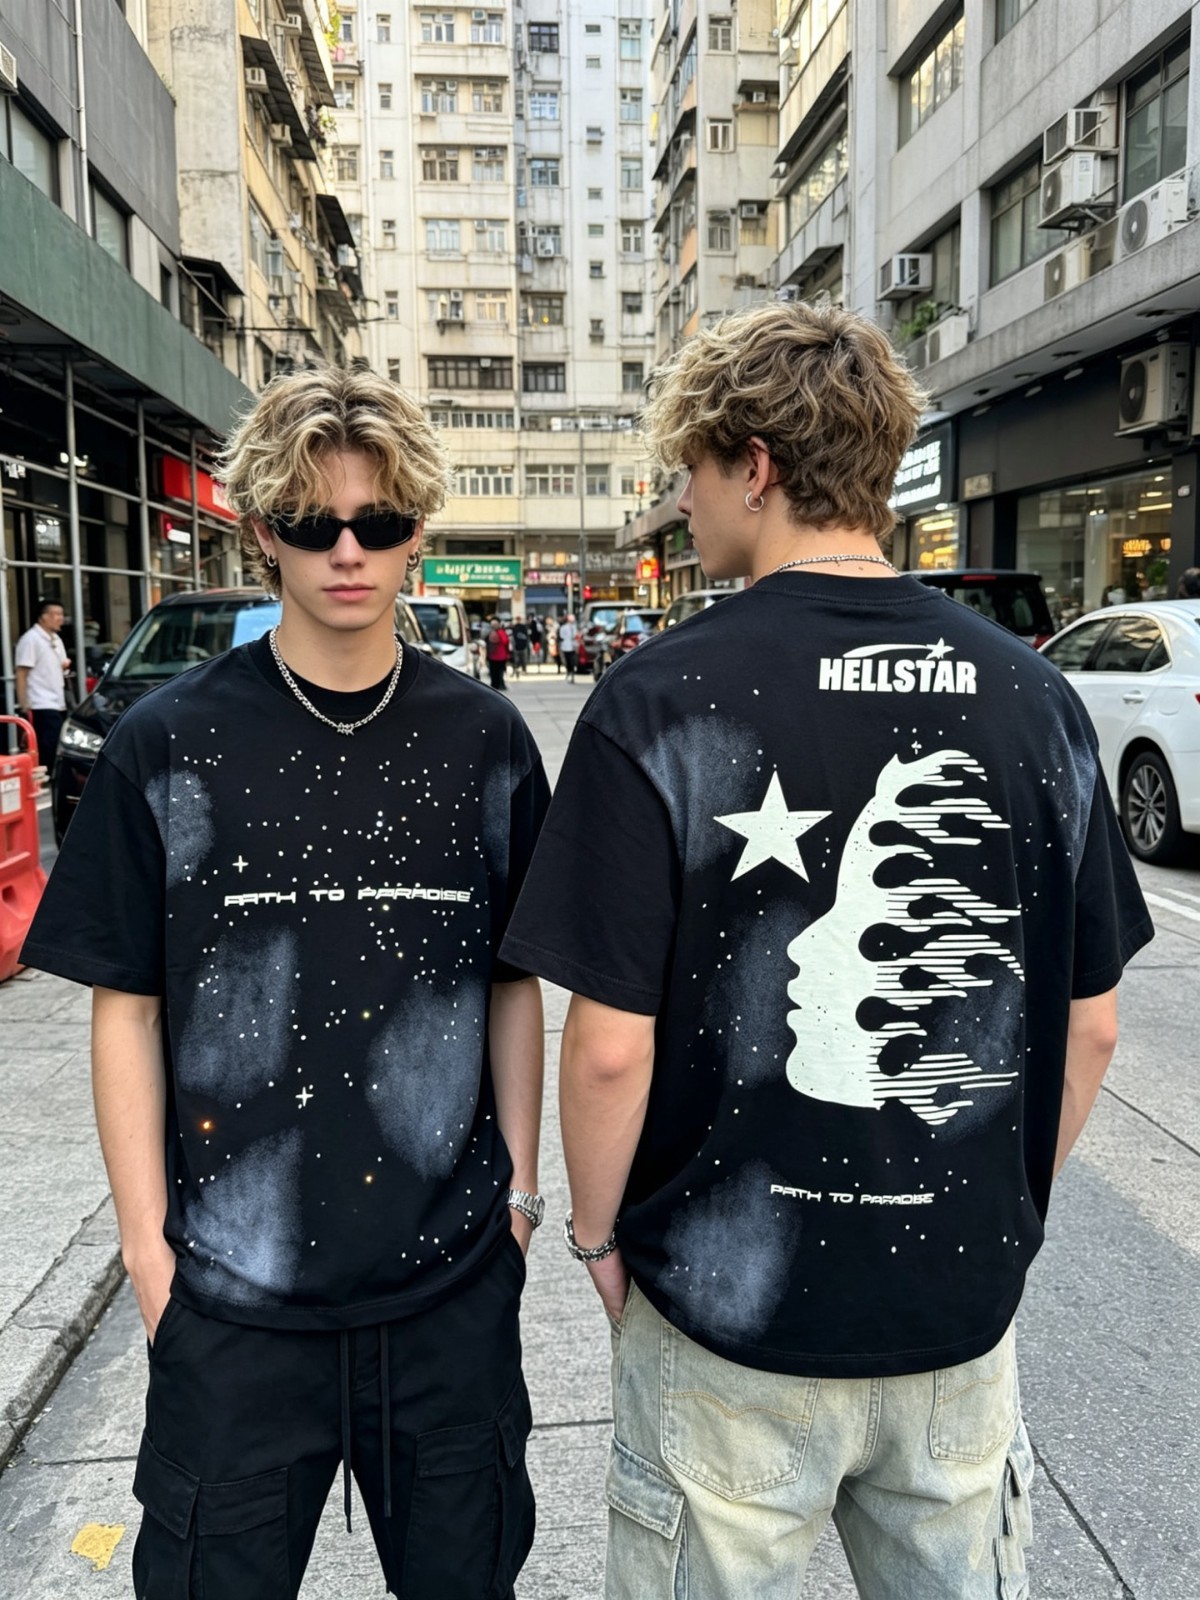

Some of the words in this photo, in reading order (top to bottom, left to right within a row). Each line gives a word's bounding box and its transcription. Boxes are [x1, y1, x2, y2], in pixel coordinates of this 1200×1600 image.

[818, 658, 977, 694] HELLSTAR
[309, 889, 345, 902] TO
[357, 887, 471, 903] PARADISE
[770, 1184, 822, 1202] PATH
[828, 1192, 854, 1203] TO
